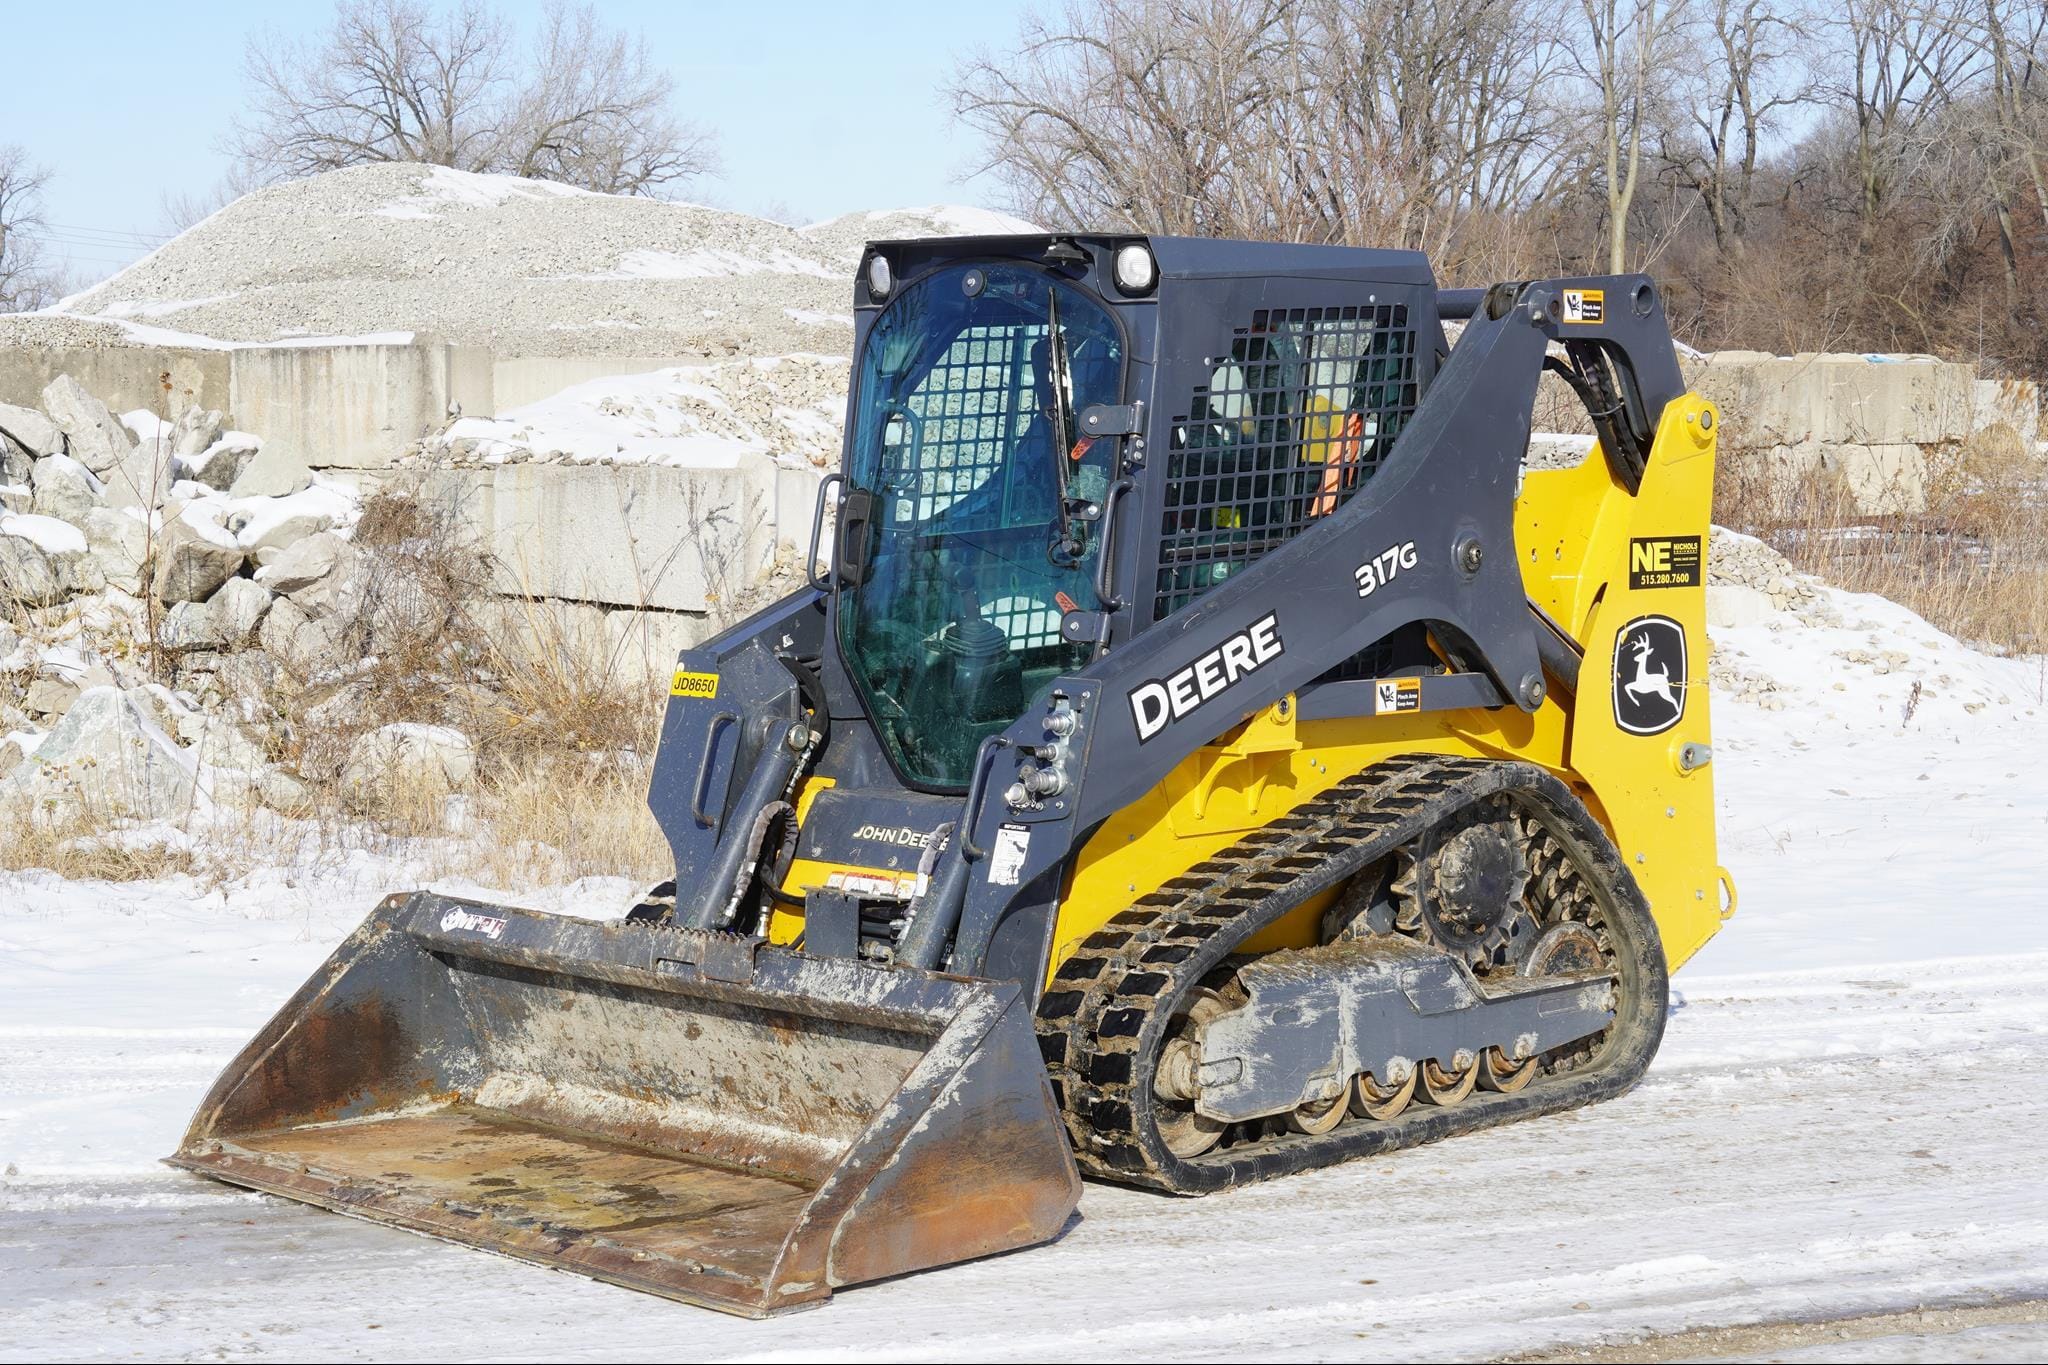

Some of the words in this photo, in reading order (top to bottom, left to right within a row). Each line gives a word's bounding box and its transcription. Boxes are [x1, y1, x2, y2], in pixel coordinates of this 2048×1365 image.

[1632, 541, 1671, 572] NE
[1673, 542, 1698, 551] NICHOLS
[1354, 541, 1419, 598] 317G
[1641, 572, 1689, 585] 515.280.7600
[674, 677, 715, 692] JD8650
[1130, 614, 1283, 741] DEERE
[853, 825, 898, 843] JOHN
[897, 828, 950, 851] DEEE
